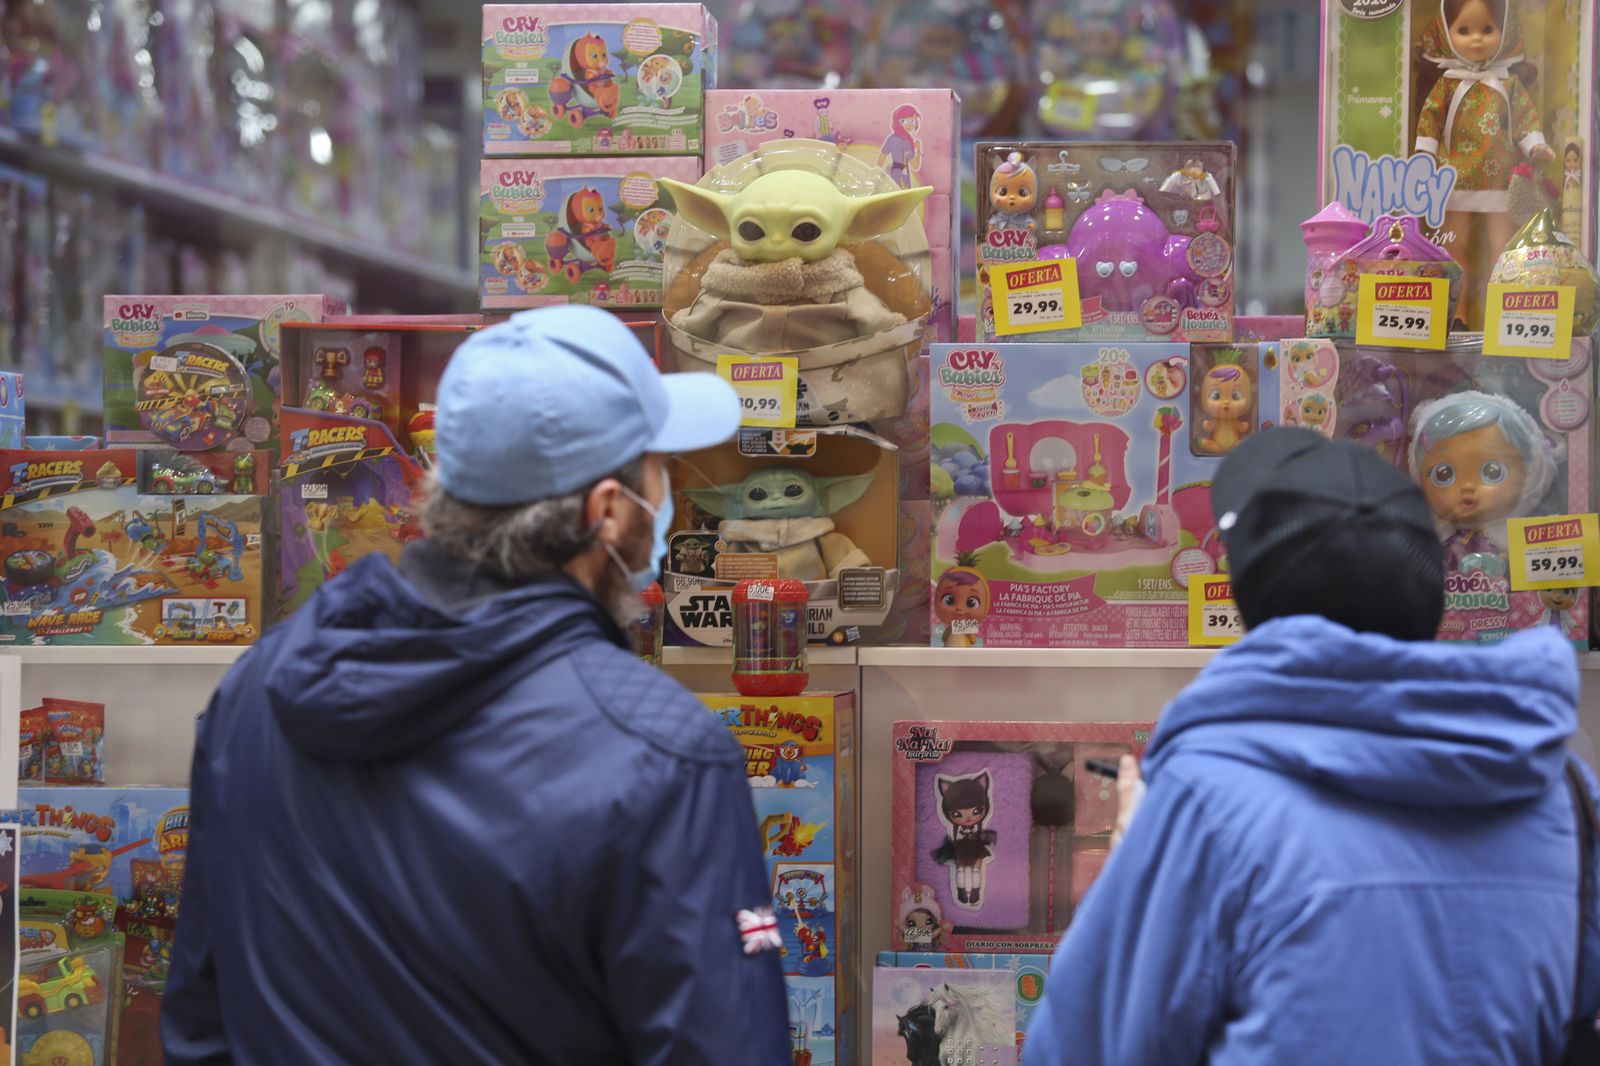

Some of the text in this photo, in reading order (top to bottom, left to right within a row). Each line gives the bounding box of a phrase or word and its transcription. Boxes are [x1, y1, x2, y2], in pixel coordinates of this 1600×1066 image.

[502, 15, 540, 33] CRY
[498, 170, 536, 187] CRY
[1333, 146, 1457, 228] NANCY
[988, 229, 1028, 248] CRY
[1009, 266, 1060, 288] OFERTA
[1377, 285, 1430, 298] OFERTA
[1504, 294, 1556, 309] OFERTA
[118, 303, 156, 320] CRY
[949, 350, 995, 371] CRY
[733, 365, 781, 379] OFERTA
[940, 366, 1002, 385] Babies
[1527, 523, 1581, 542] OFERTA
[1010, 583, 1070, 594] PIA'S FACTORY
[1445, 571, 1491, 593] ebés
[999, 591, 1082, 604] LA FABRIQUE DE PIA
[1207, 585, 1233, 599] OFE
[680, 595, 731, 611] STA
[1444, 593, 1507, 609] orones
[680, 611, 733, 628] WAR
[807, 608, 833, 621] RIAN
[1471, 616, 1505, 629] DRESSY
[808, 622, 825, 634] ILD
